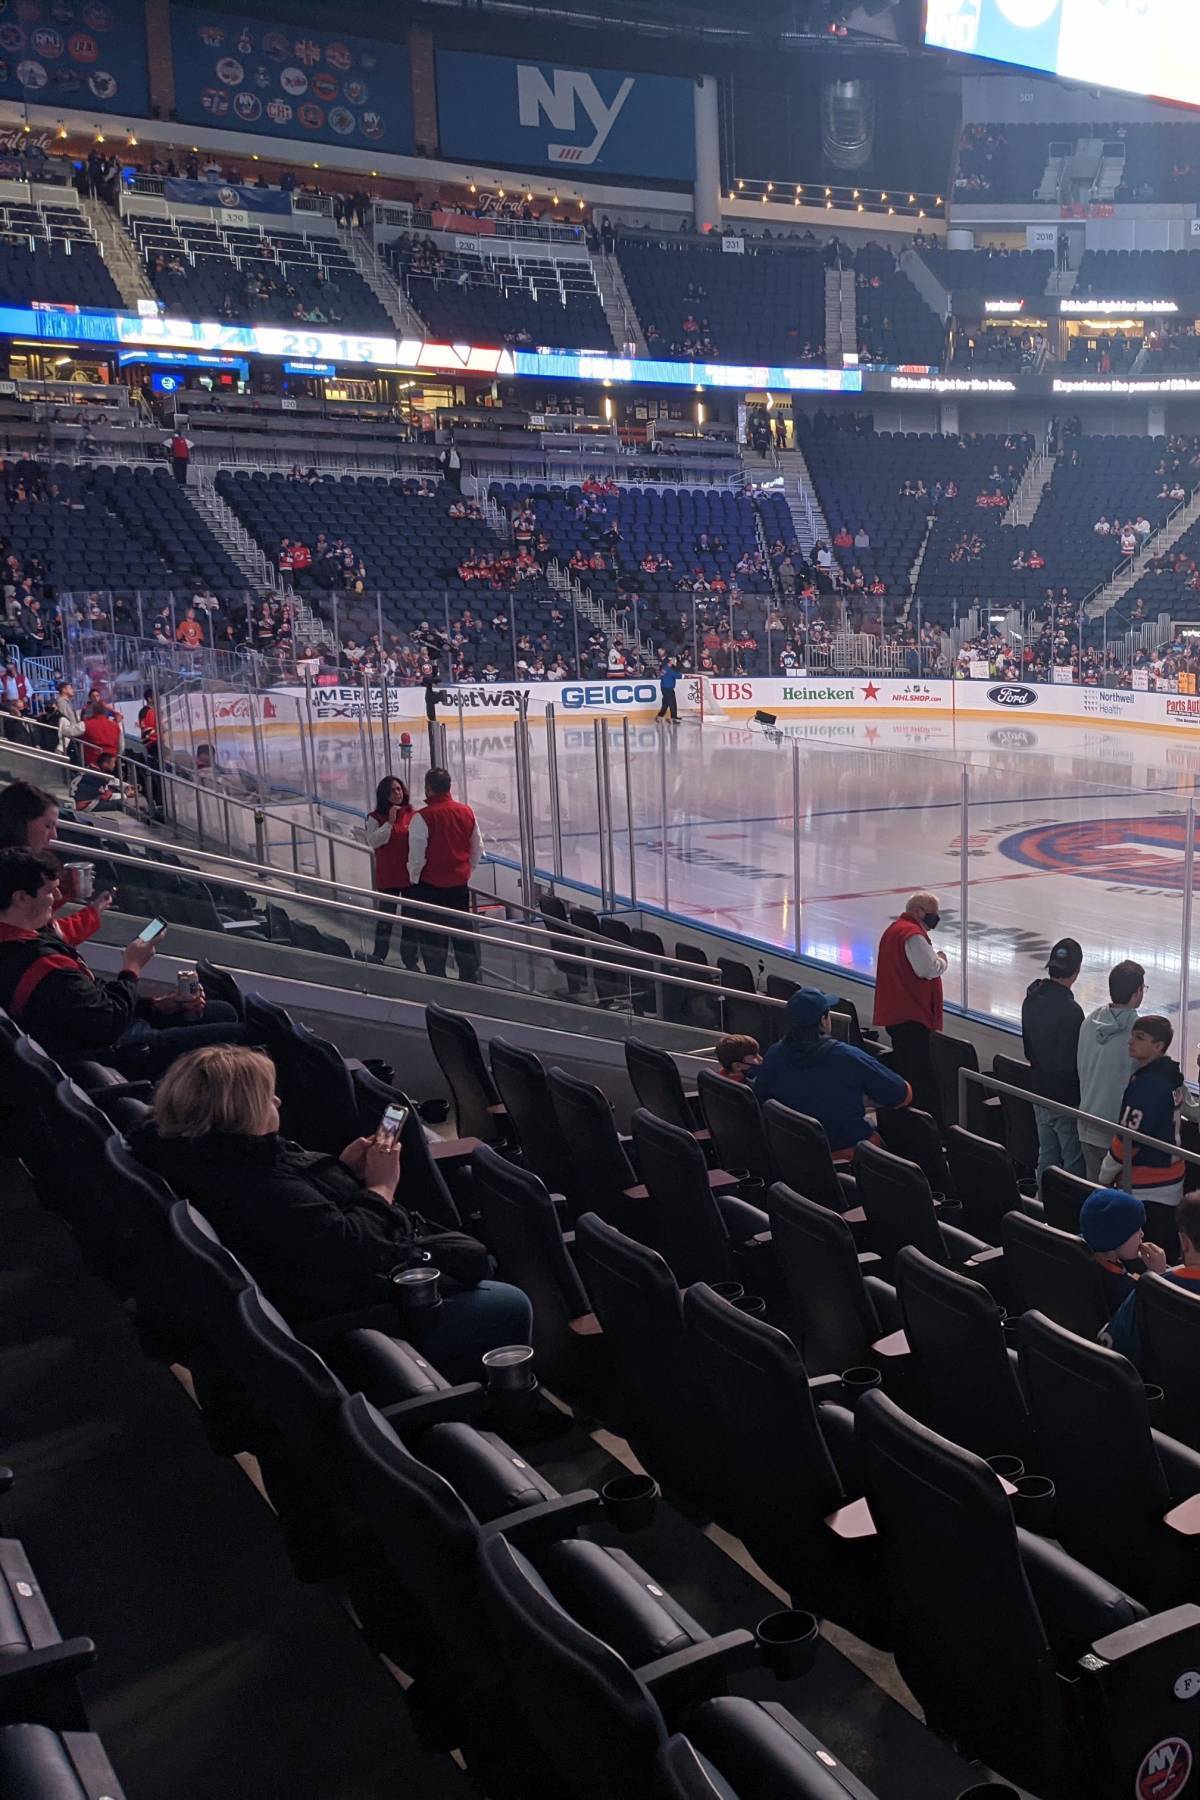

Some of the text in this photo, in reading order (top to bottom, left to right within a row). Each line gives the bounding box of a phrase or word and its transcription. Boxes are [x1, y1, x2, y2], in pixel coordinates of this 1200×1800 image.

[458, 241, 474, 251] 230
[726, 240, 739, 249] 231
[561, 684, 656, 708] GEICO
[711, 683, 753, 701] UBS
[783, 687, 855, 701] Heineken
[1100, 692, 1135, 704] Northwell
[1167, 700, 1186, 712] Parts
[1120, 1105, 1144, 1130] 13
